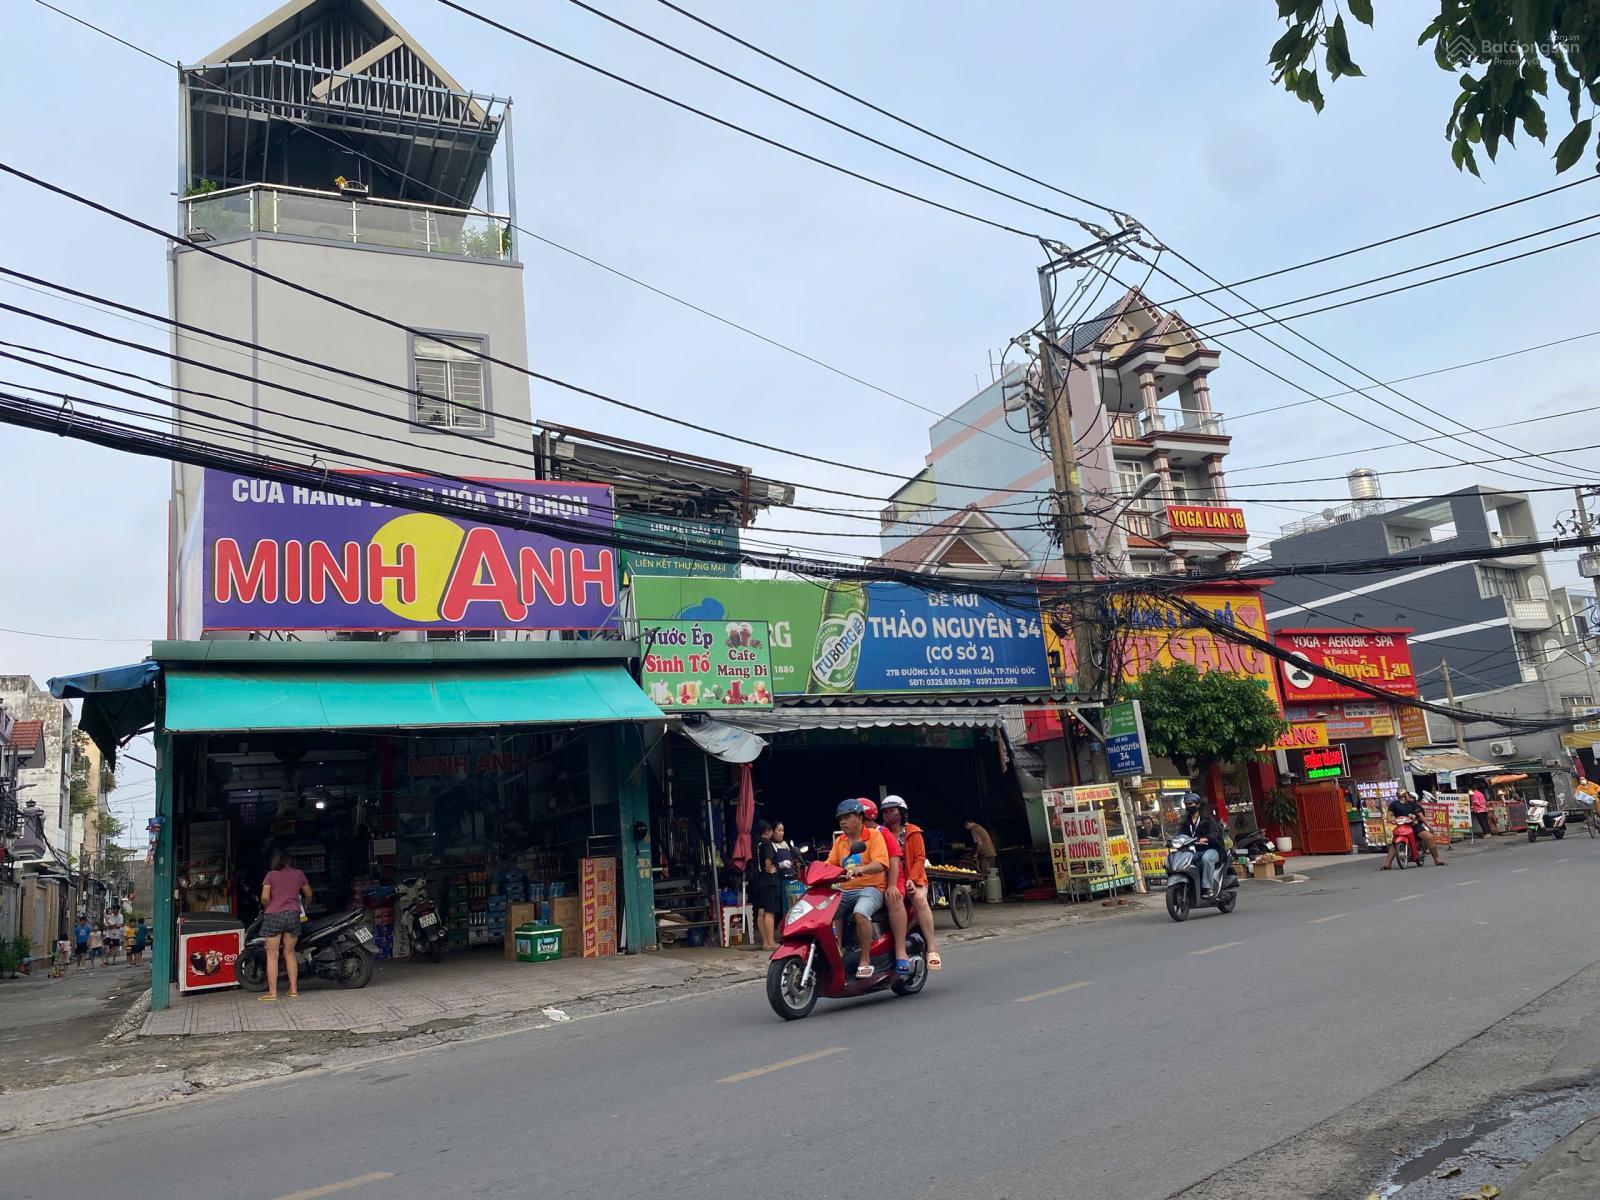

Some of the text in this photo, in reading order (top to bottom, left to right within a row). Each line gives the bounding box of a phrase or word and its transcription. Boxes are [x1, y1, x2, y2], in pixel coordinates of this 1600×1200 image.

[1172, 510, 1244, 530] YOGA LAN 18
[214, 526, 615, 622] MINH ANH
[635, 559, 654, 568] LIÊN
[656, 557, 671, 569] KẾT
[711, 563, 726, 573] MẠI
[868, 609, 1041, 638] THẢO NGUYÊN 34
[643, 623, 713, 649] Nước Ép
[1292, 636, 1320, 648] YOGA
[1328, 635, 1369, 648] AEROBIC
[1376, 635, 1394, 647] SPA
[645, 652, 711, 673] Sinh Tố
[728, 649, 756, 661] Cafe
[815, 628, 858, 677] TUBORG
[926, 641, 994, 664] (CƠ SỞ 2)
[1168, 636, 1266, 676] SANG
[717, 664, 768, 678] Mang Đi
[901, 667, 928, 676] ĐƯỜNG
[929, 667, 939, 676] SỐ
[949, 668, 972, 676] P.LINH
[973, 667, 995, 677] XUÂN,
[995, 666, 1020, 675] TP.THỦ
[1021, 666, 1036, 675] ĐỨC
[1379, 655, 1411, 680] Lan
[1275, 726, 1319, 746] ANG
[408, 755, 468, 776] MINH
[1119, 752, 1130, 760] 34
[1064, 816, 1098, 837] CÁ LÓC
[1068, 839, 1101, 859] NƯỚNG
